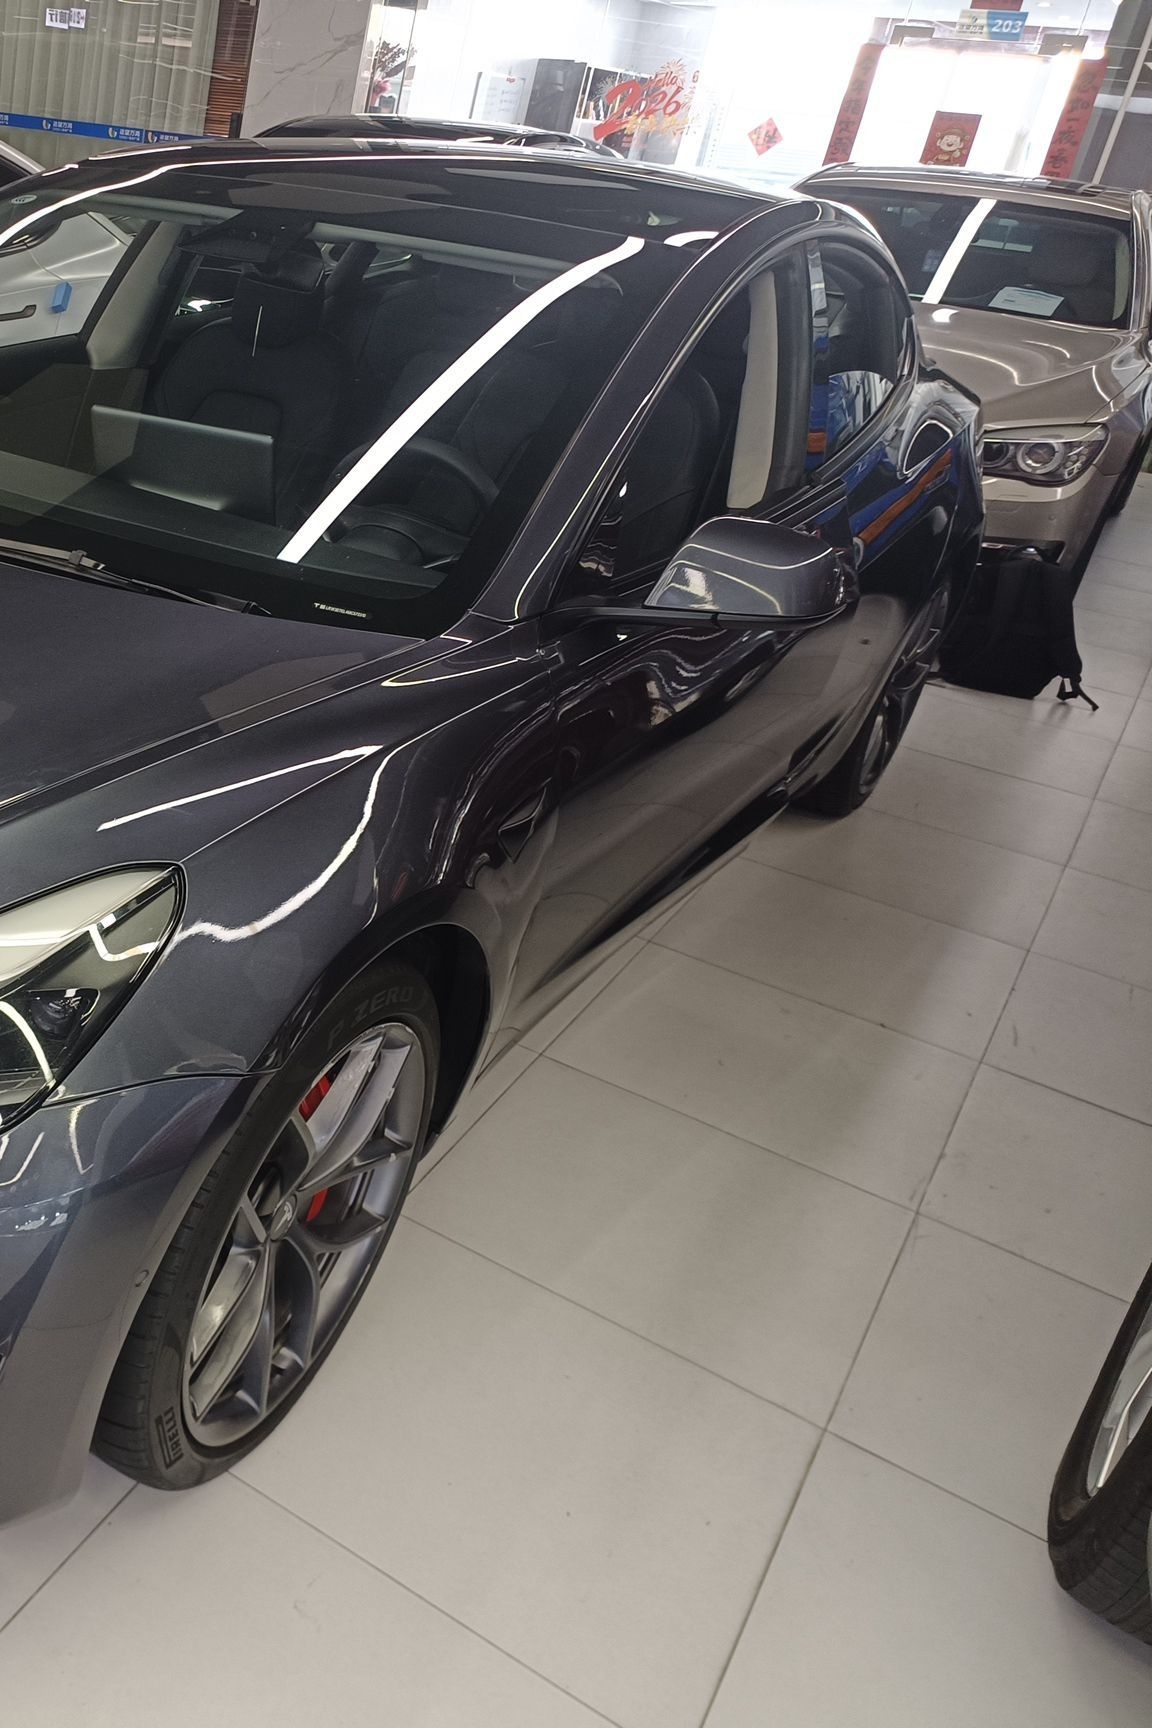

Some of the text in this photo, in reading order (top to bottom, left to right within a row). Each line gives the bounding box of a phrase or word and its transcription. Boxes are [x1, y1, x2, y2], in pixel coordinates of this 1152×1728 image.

[991, 19, 1023, 33] 203
[594, 80, 684, 141] 2026
[351, 986, 416, 1029] ZERO
[155, 1405, 184, 1469] PIRELLI
